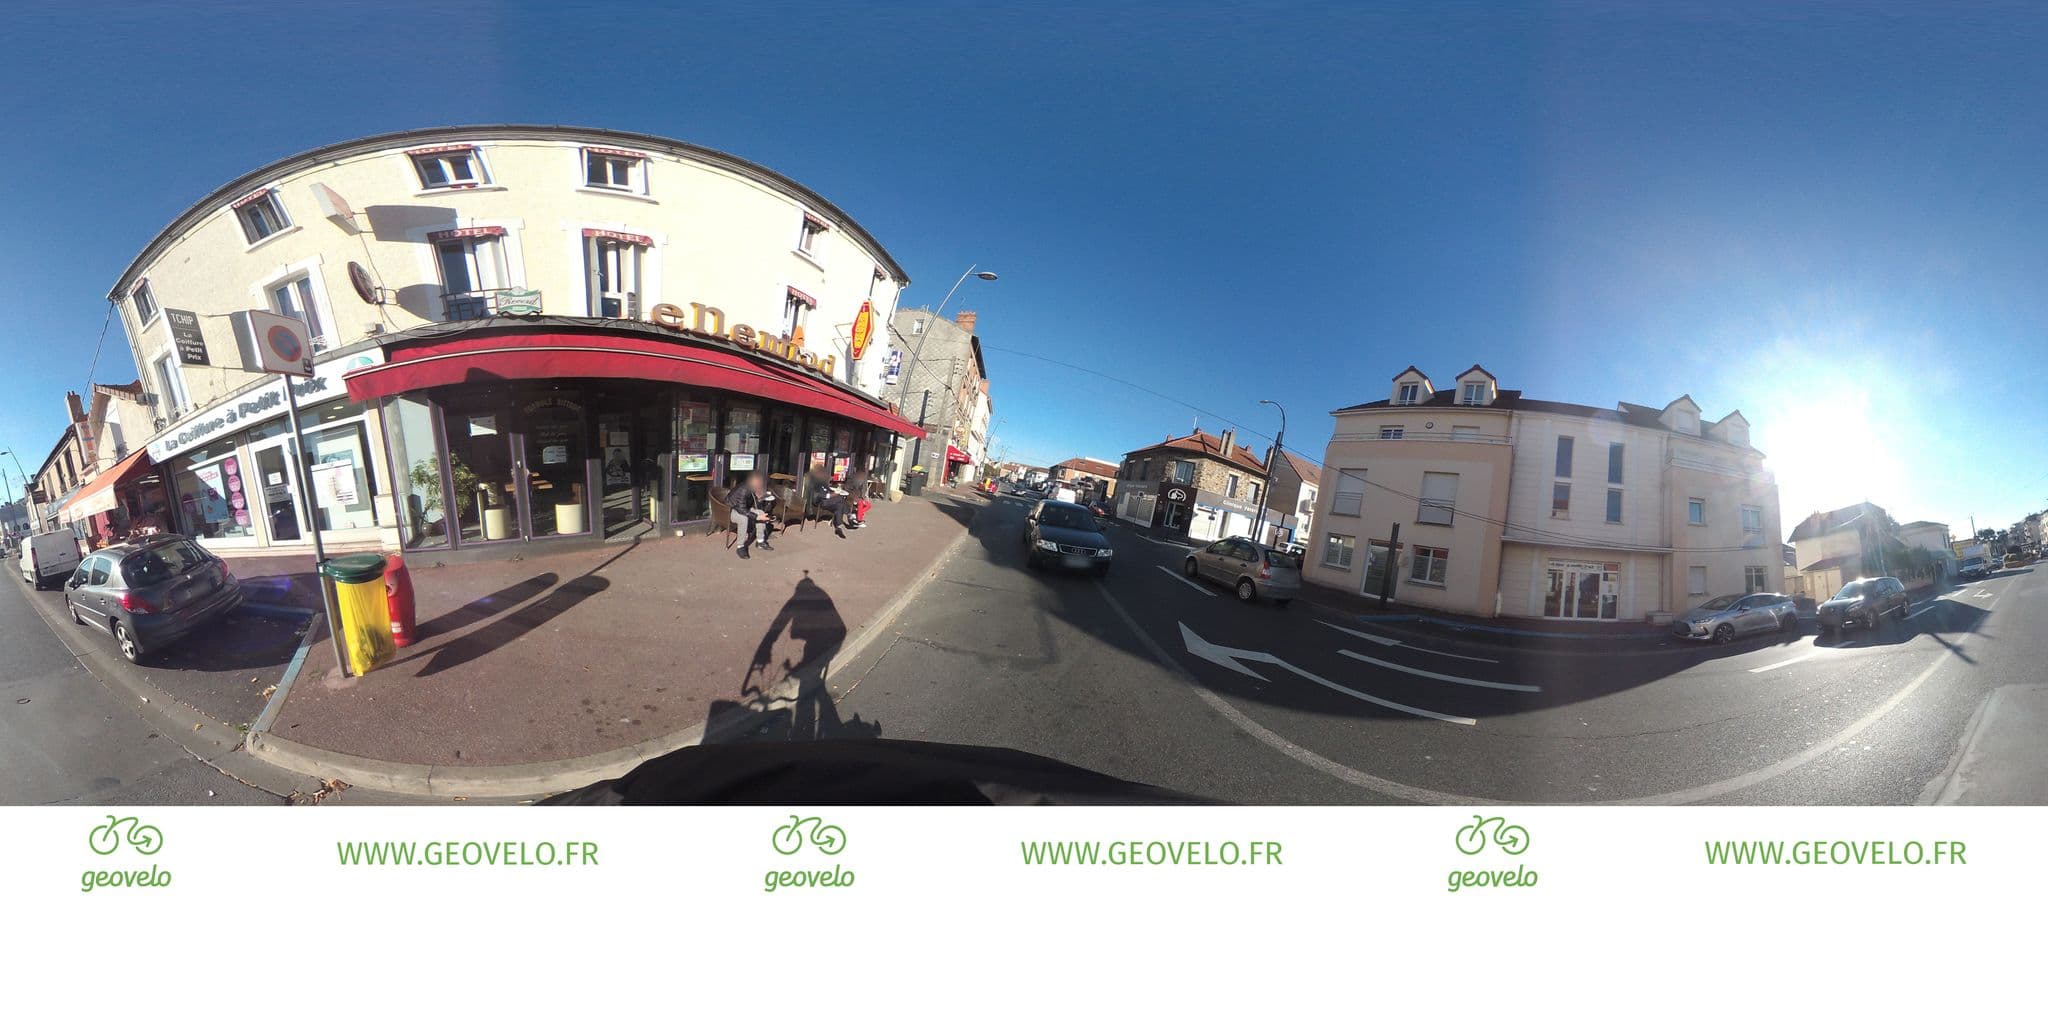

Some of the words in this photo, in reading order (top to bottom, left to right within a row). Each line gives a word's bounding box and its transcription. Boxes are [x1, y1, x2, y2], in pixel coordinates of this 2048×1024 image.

[438, 228, 490, 238] HOTEL
[594, 230, 643, 243] HOTEL
[170, 312, 194, 325] TCHIP
[176, 337, 204, 346] Coiffure
[185, 346, 203, 354] Petit
[187, 353, 202, 361] Prix
[178, 417, 225, 445] Coiffure
[226, 409, 237, 424] à
[238, 390, 281, 418] Petit
